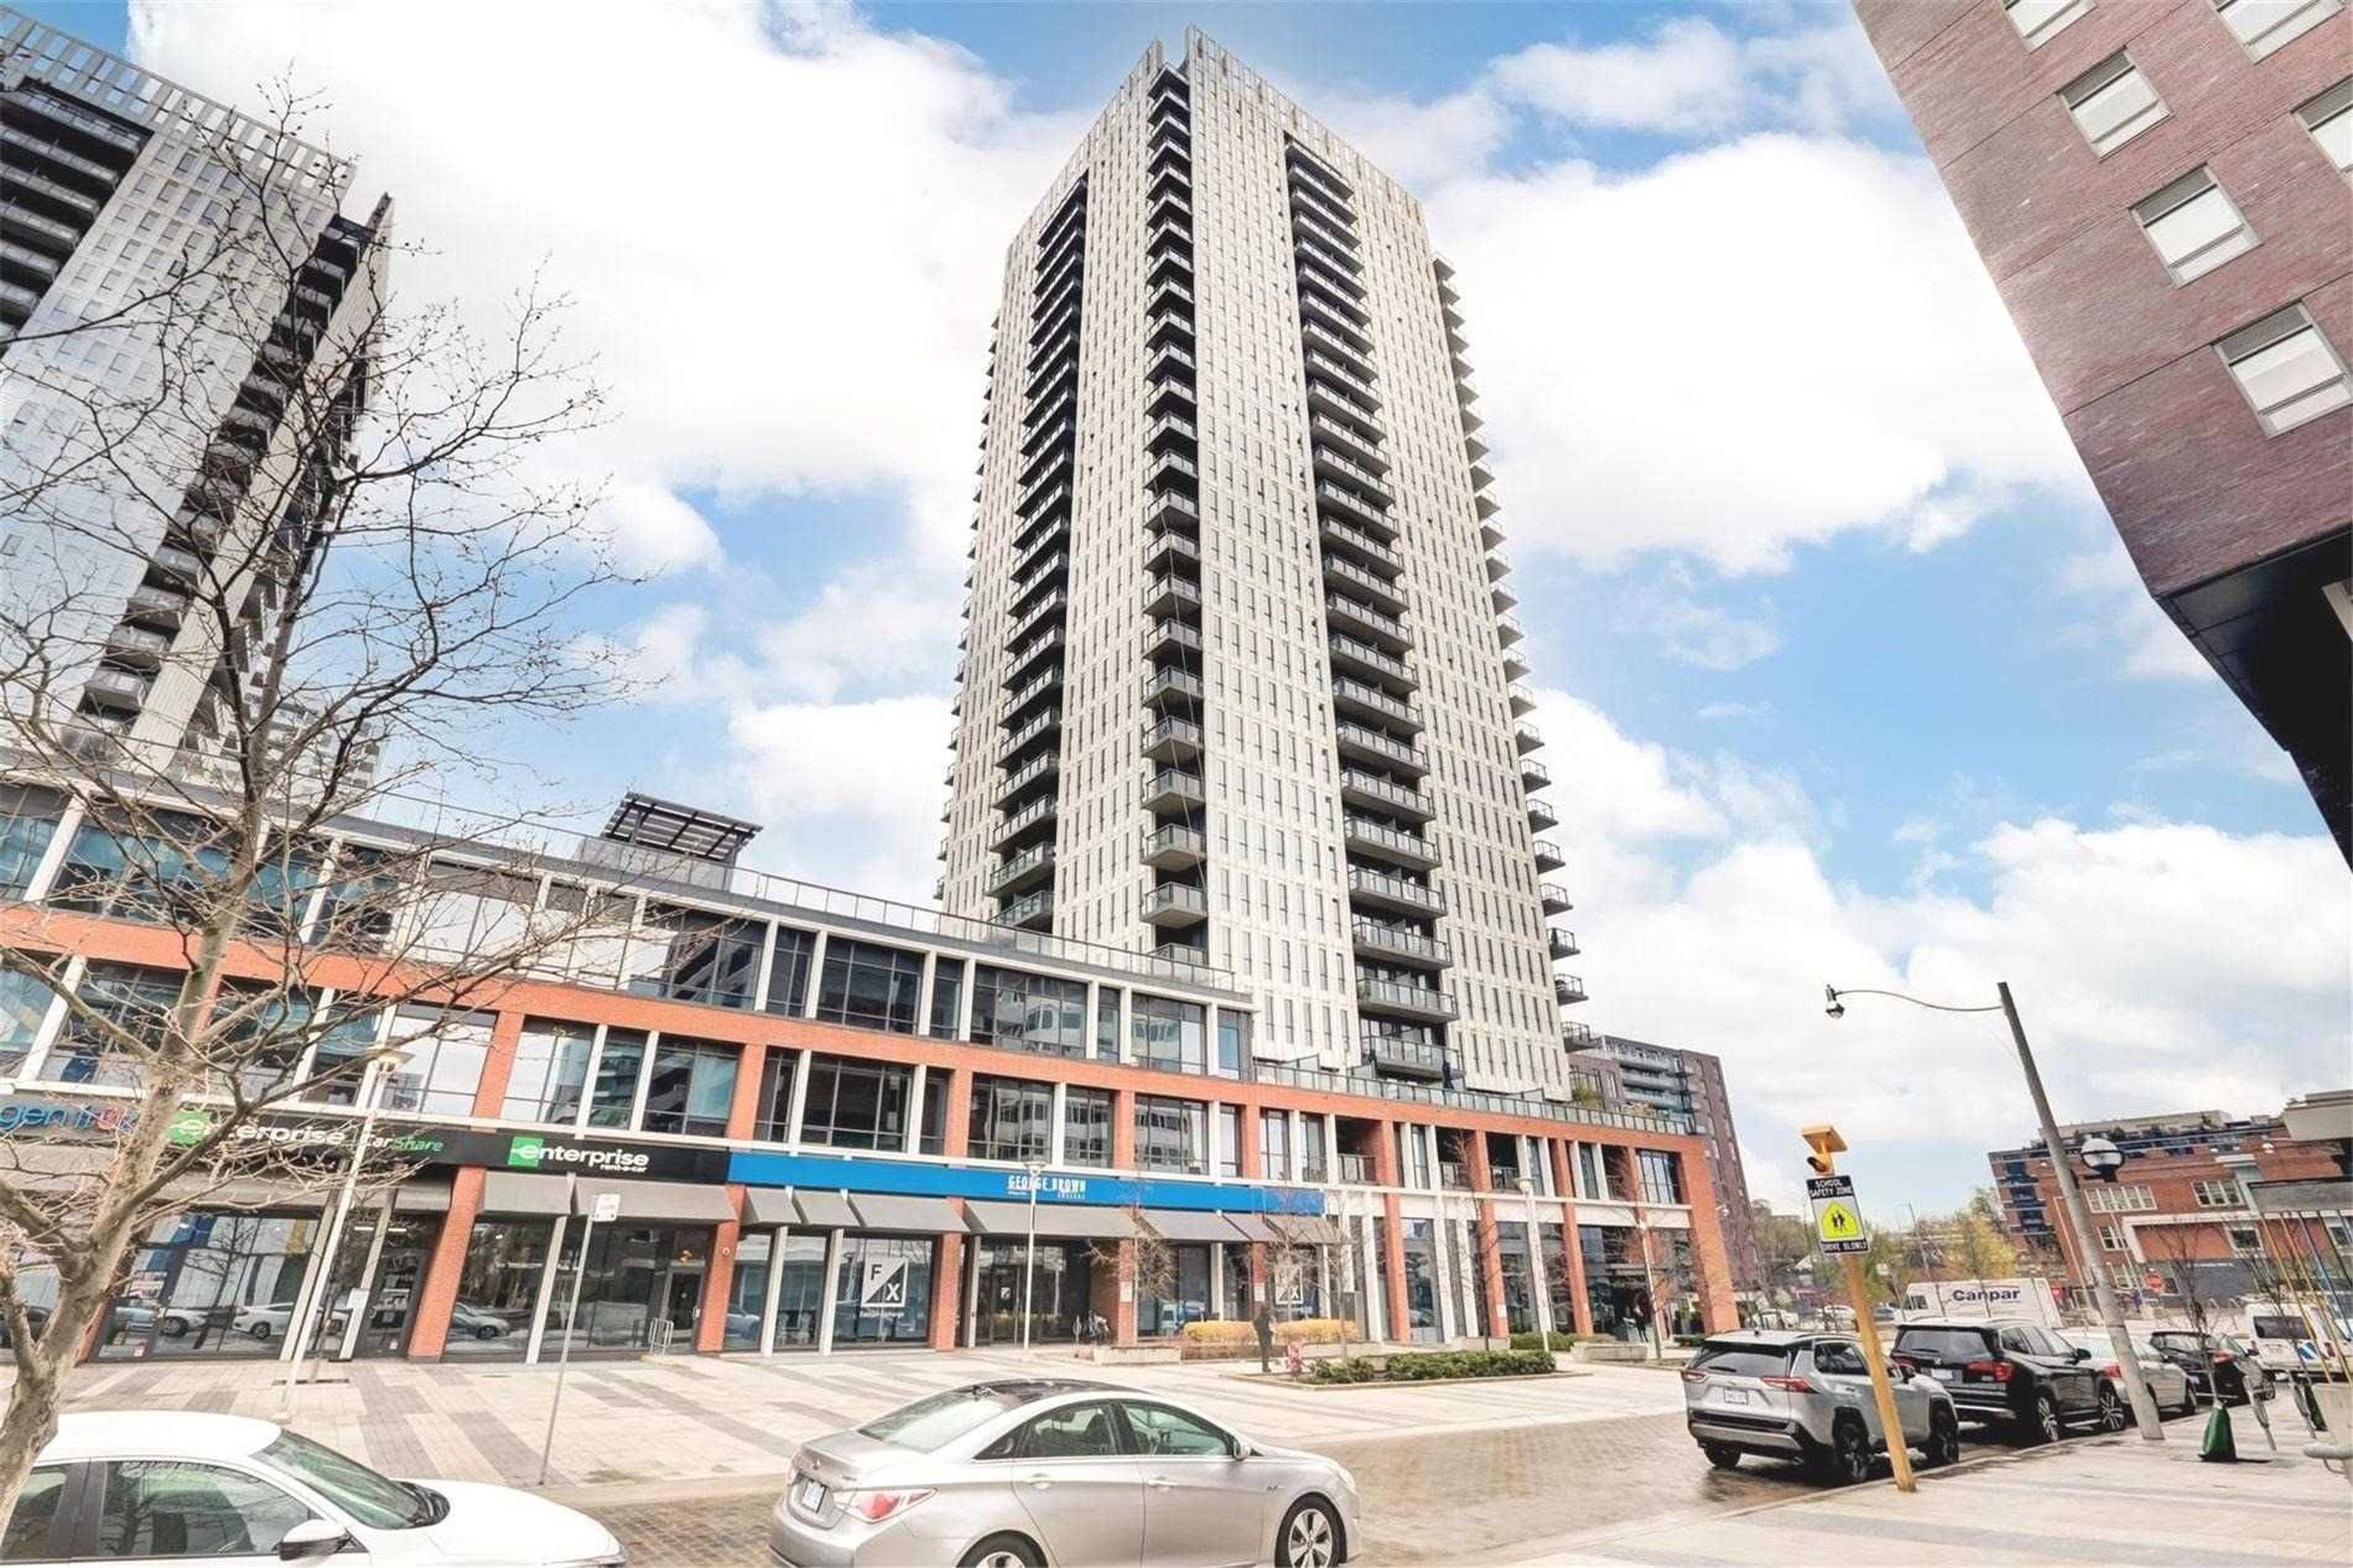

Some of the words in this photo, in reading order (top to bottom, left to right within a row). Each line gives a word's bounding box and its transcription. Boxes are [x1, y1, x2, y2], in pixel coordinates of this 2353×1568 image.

[512, 1144, 650, 1168] enterprise
[1051, 1177, 1086, 1193] BROWN
[871, 1264, 882, 1281] F
[886, 1282, 900, 1301] X
[1952, 1289, 2021, 1301] Canpar
